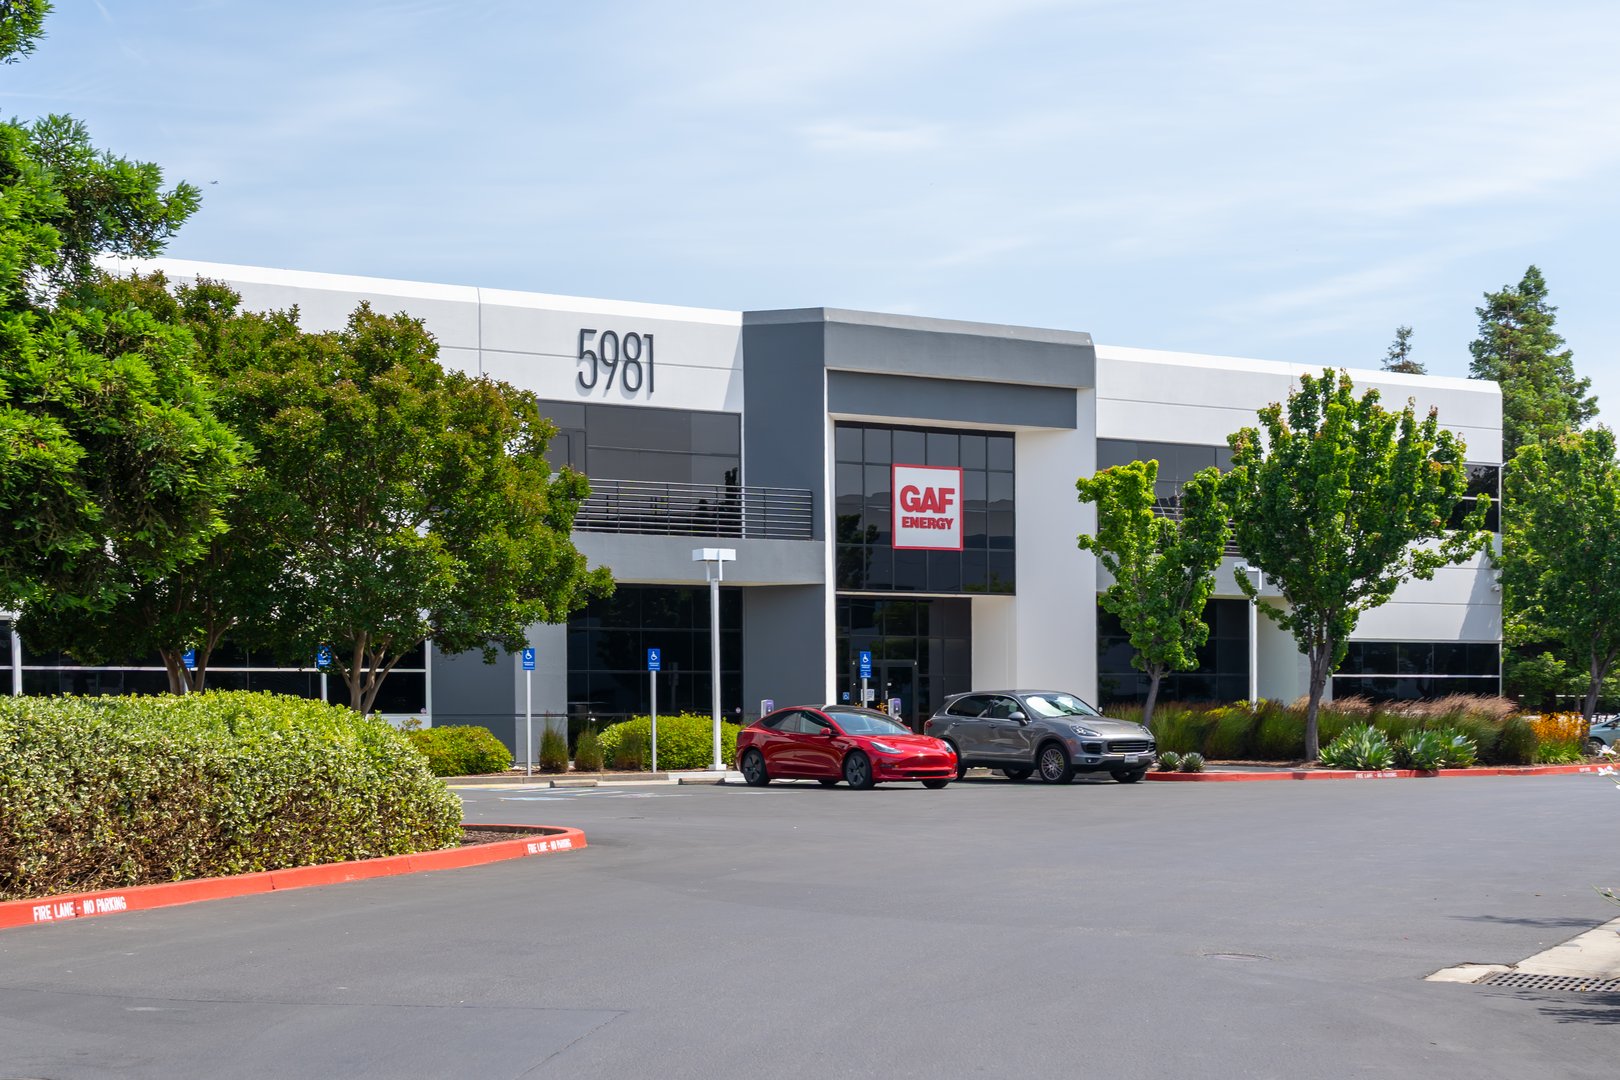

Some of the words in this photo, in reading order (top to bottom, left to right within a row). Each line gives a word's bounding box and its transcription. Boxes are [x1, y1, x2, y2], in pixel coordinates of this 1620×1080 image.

[578, 328, 654, 393] 5981
[899, 484, 955, 514] GAF
[901, 516, 954, 530] ENERGY
[33, 905, 52, 921] FIRE
[53, 902, 75, 917] LANE
[83, 900, 95, 914] NO
[96, 896, 127, 912] PARKING
